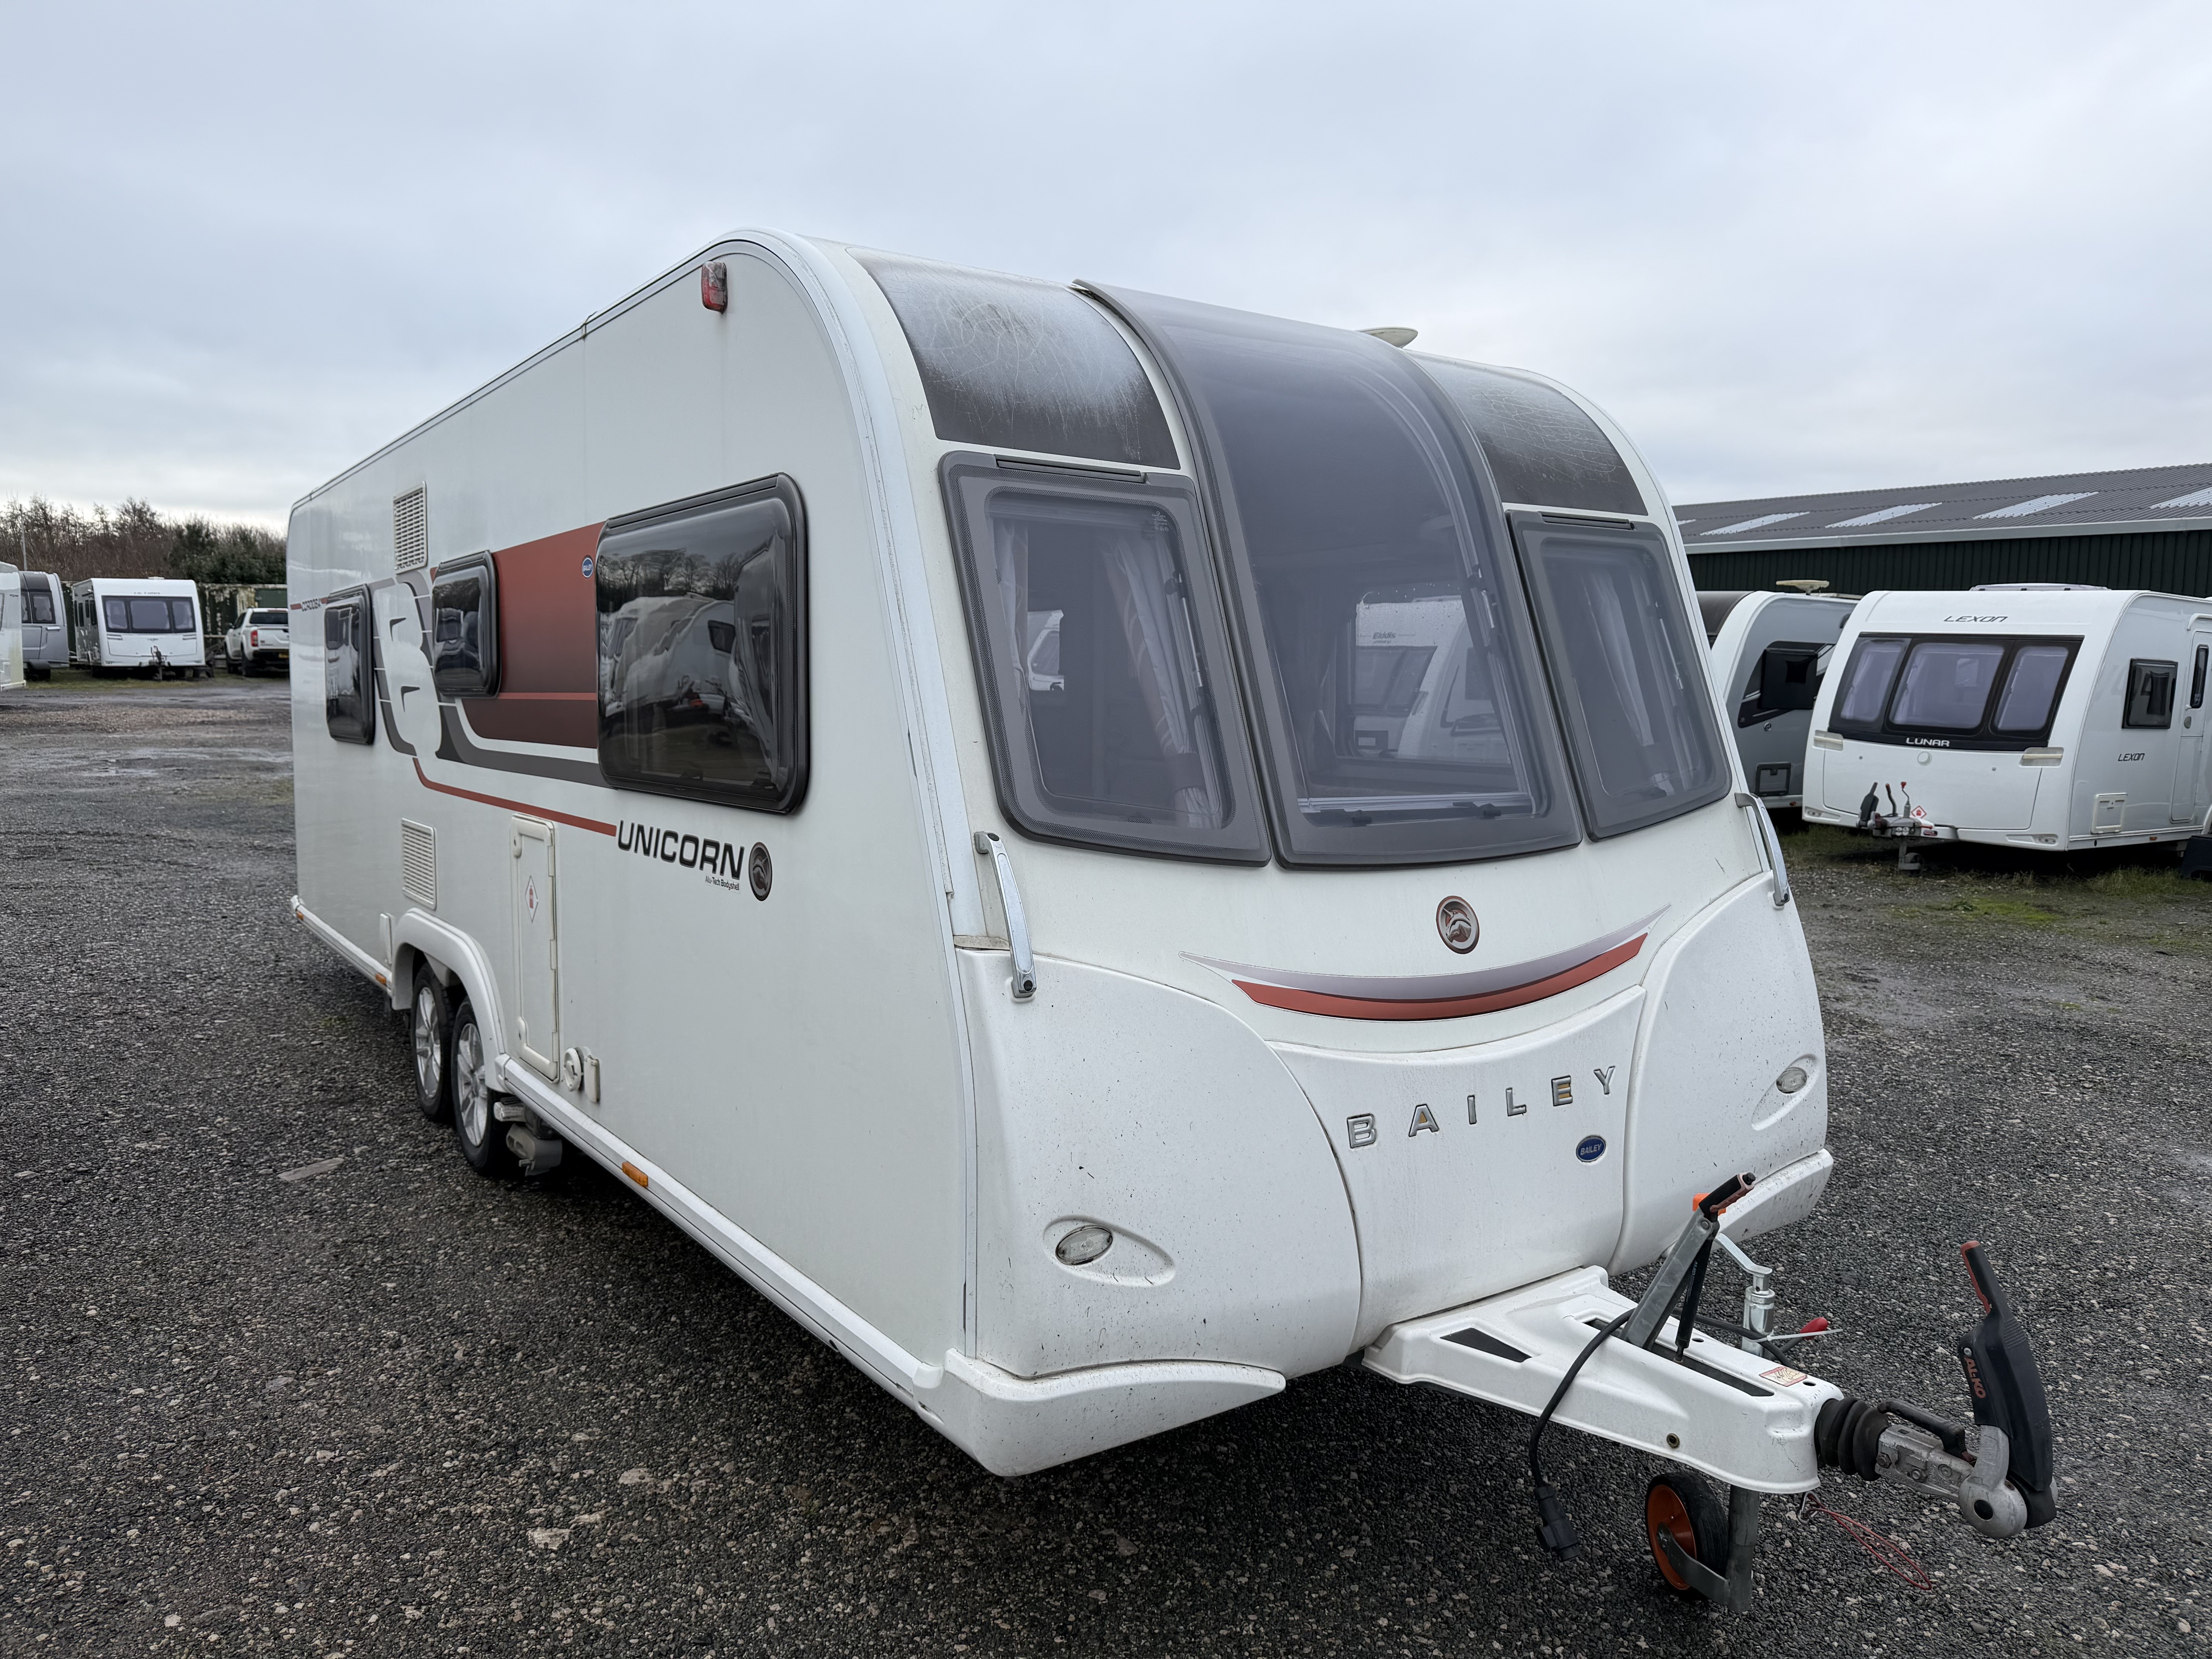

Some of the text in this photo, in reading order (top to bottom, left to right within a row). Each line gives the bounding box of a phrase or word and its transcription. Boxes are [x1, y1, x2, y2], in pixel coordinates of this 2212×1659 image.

[1906, 737, 1950, 747] LUNAR
[2118, 753, 2145, 761] LEXON
[618, 820, 745, 881] UNICORN
[705, 876, 740, 891] Alu-Tech Bodyshell
[1346, 1065, 1616, 1149] BAILEY
[1580, 1143, 1602, 1156] BAILEY
[1964, 1357, 1986, 1399] AL-KO
